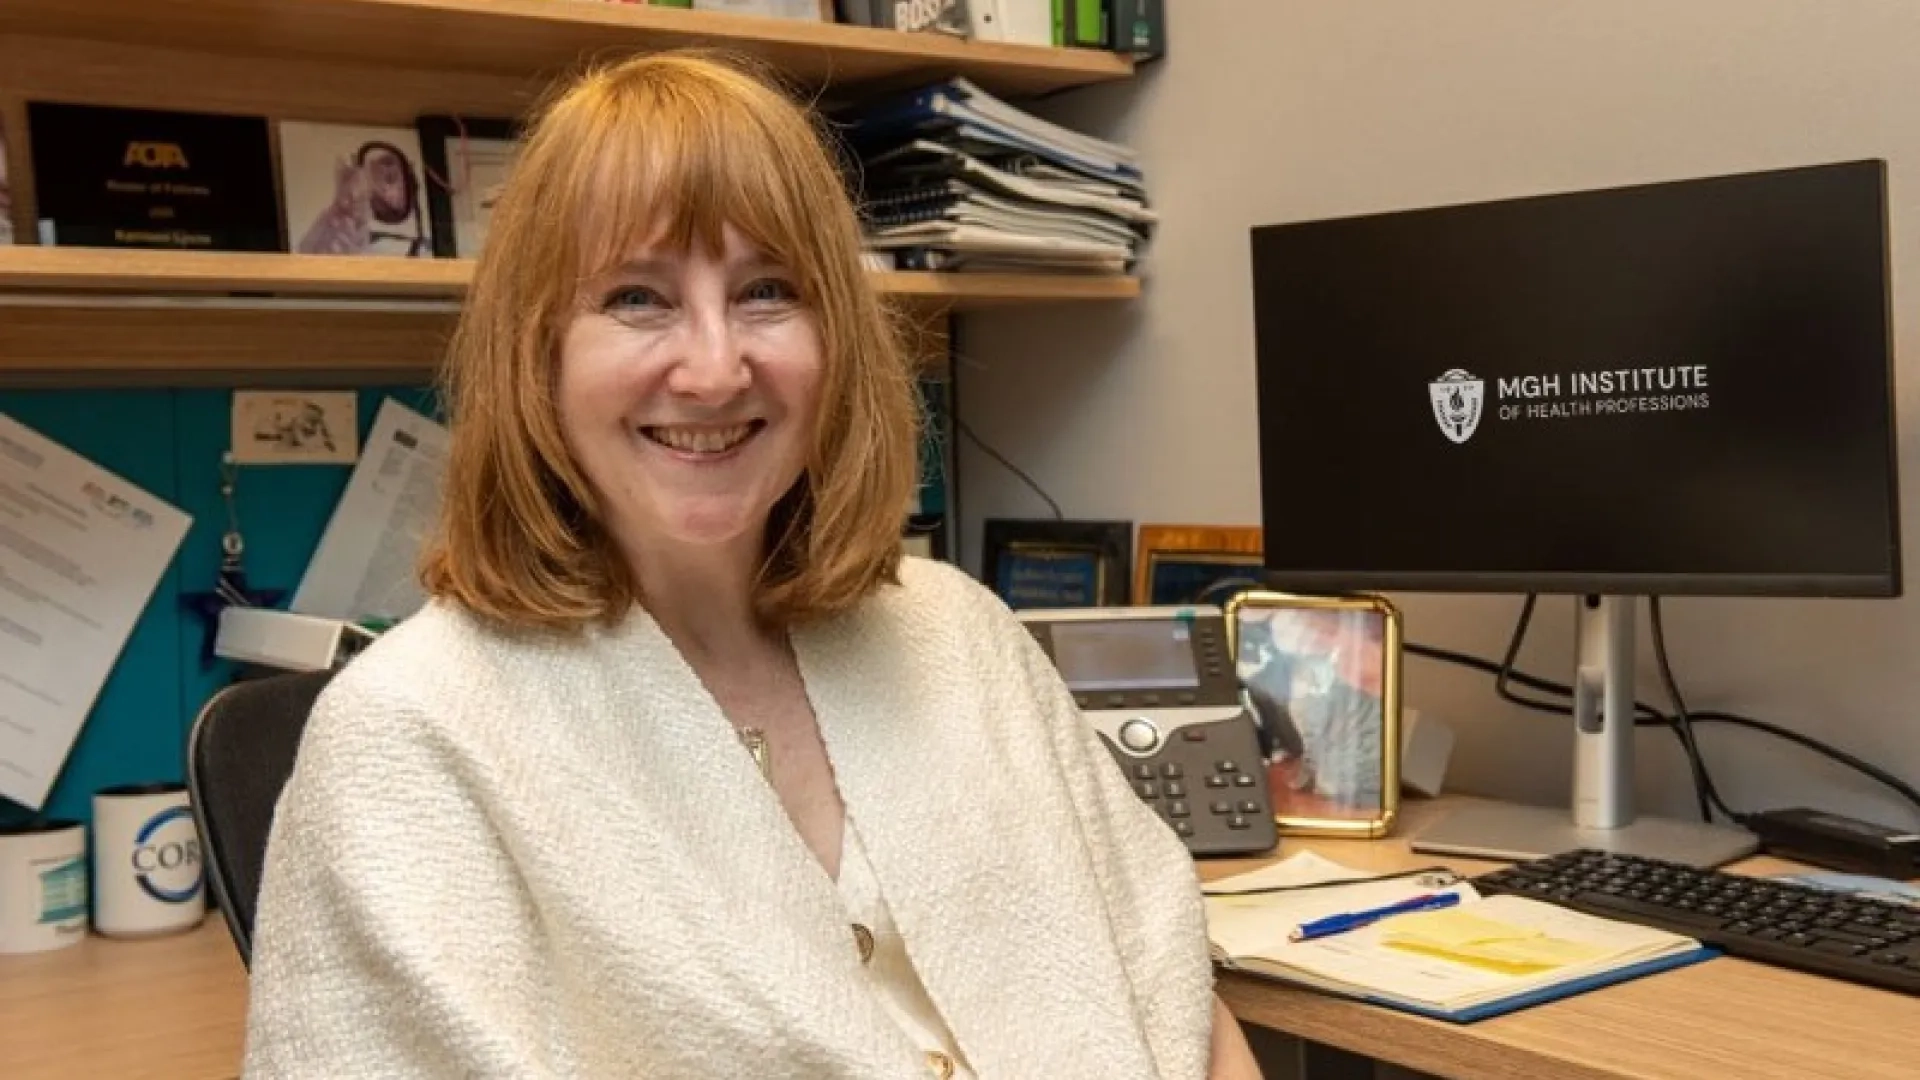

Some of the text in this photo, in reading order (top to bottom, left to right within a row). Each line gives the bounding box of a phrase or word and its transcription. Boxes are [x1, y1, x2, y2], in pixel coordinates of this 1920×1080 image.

[1498, 364, 1708, 399] MGH INSTITUTE
[1499, 392, 1709, 420] OF HEALTH PROFESSIONS
